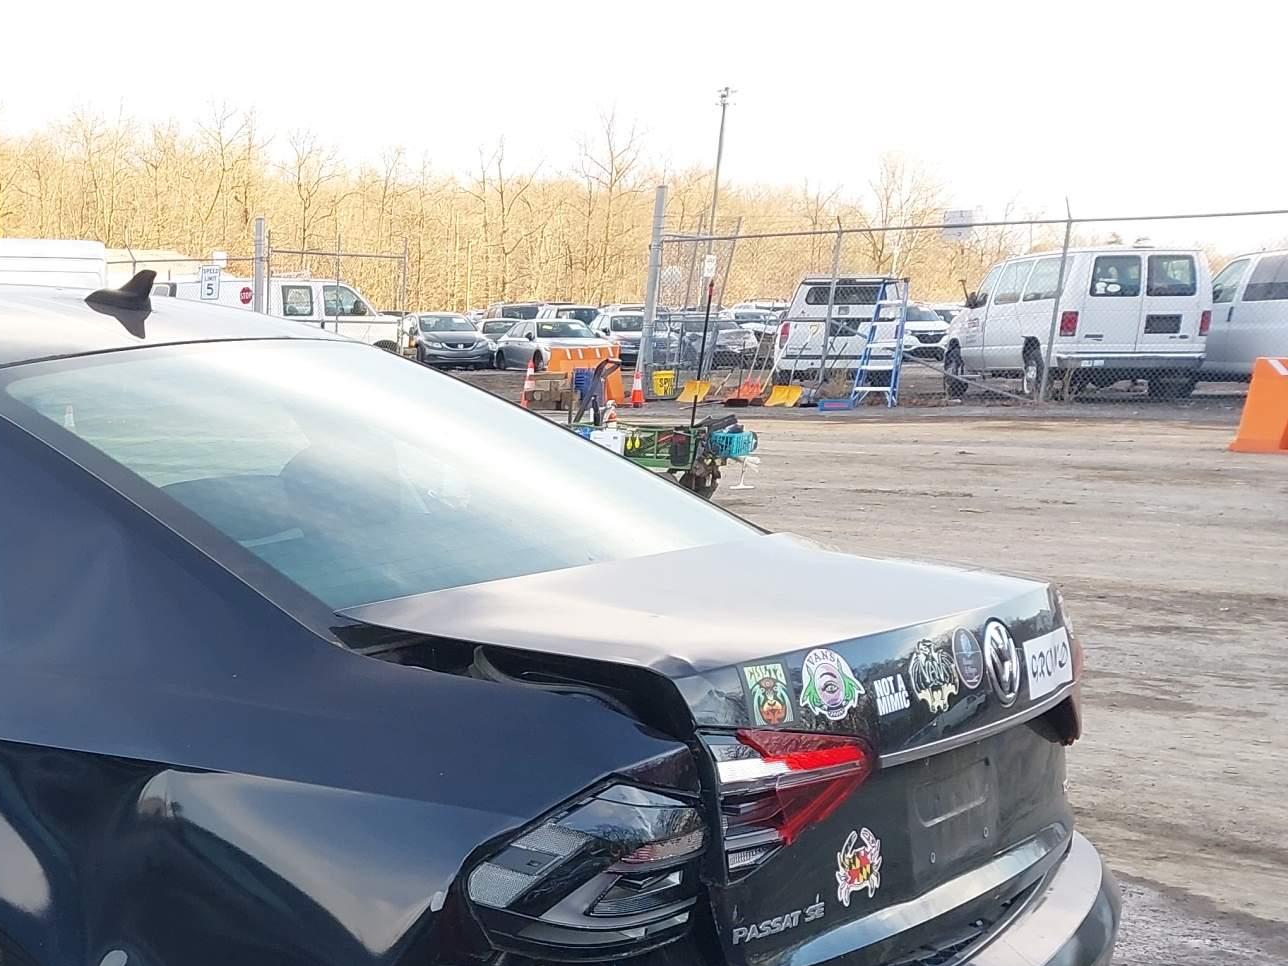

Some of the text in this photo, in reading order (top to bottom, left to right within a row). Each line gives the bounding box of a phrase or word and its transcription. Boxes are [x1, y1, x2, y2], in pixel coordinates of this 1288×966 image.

[206, 283, 214, 296] 5
[807, 650, 837, 666] VANS
[873, 673, 907, 698] NOT A
[876, 690, 911, 716] MIMIC
[732, 901, 825, 945] PASSAT SE
